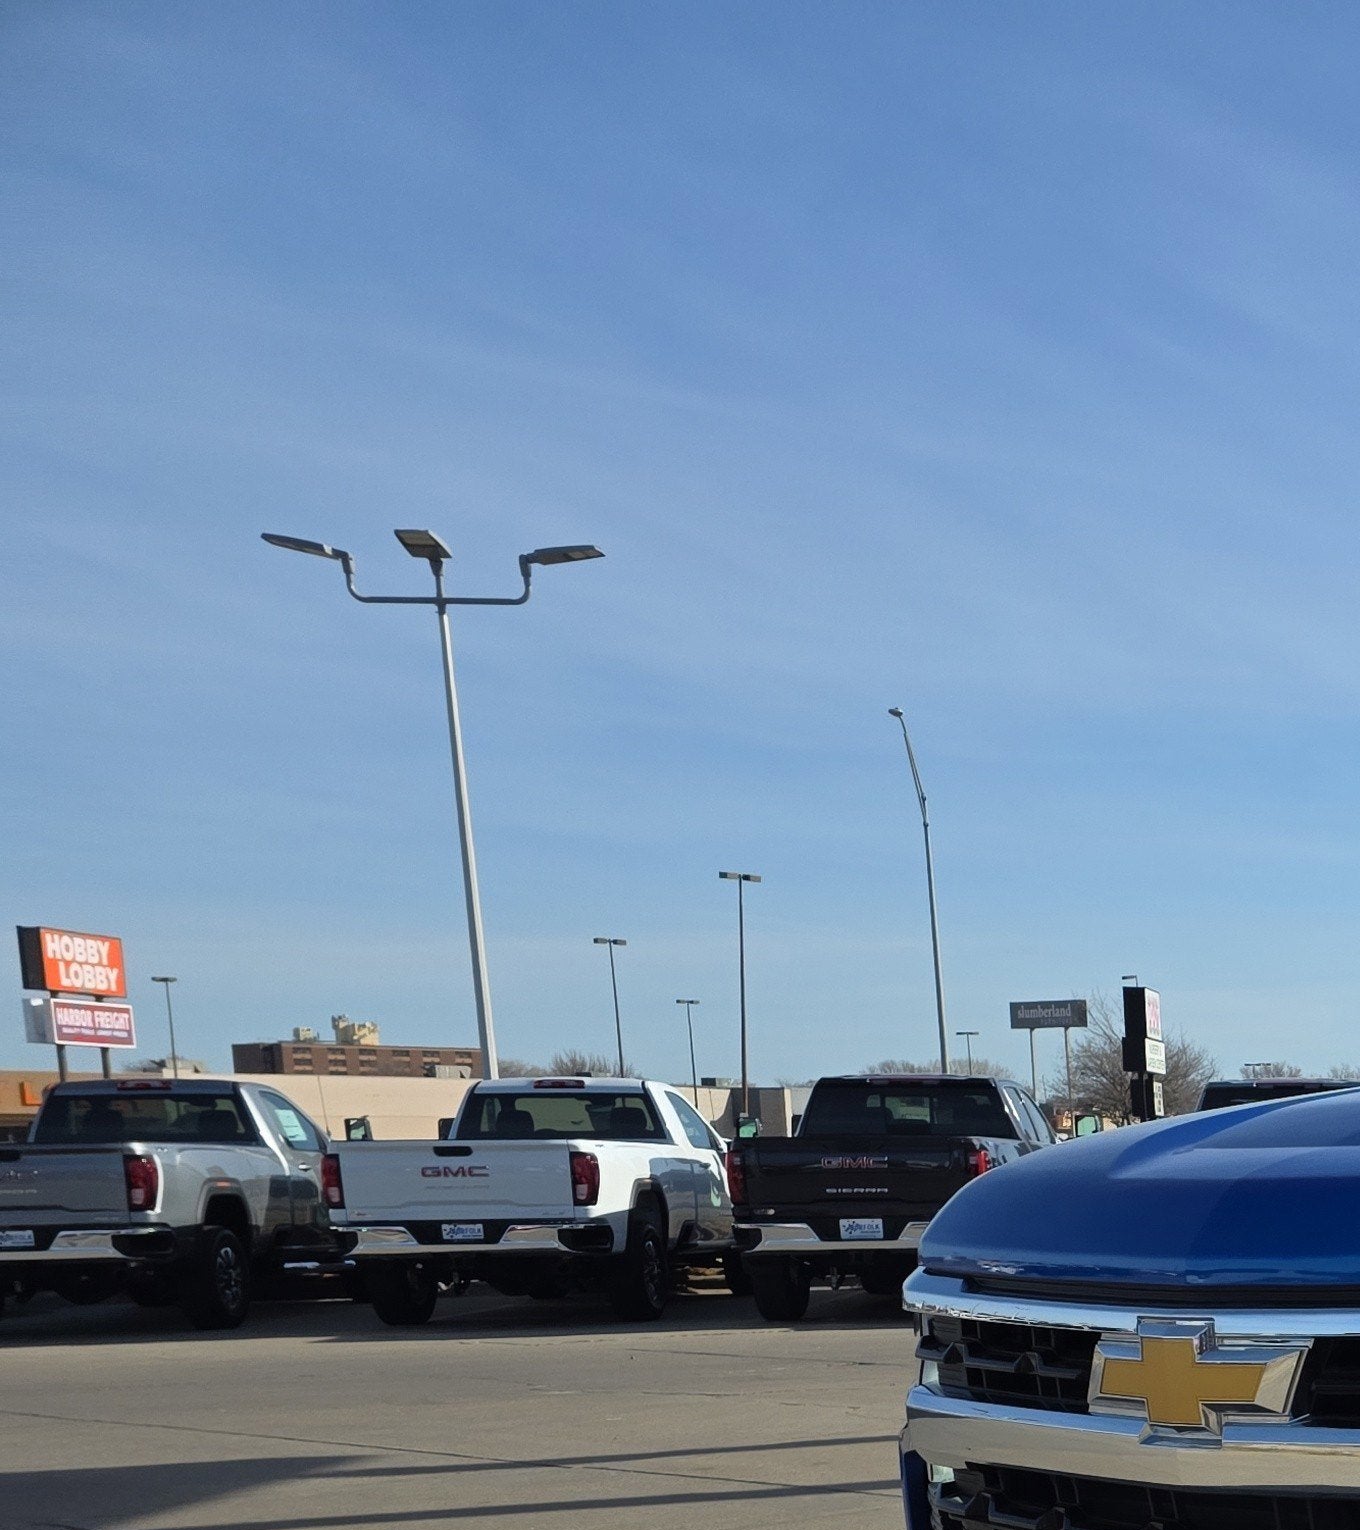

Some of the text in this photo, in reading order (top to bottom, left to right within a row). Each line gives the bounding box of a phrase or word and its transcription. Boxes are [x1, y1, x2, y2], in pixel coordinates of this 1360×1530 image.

[45, 933, 110, 965] HOBBY
[58, 961, 119, 991] LOBBY
[56, 1007, 130, 1031] HARBOR FREIGHT
[1017, 1004, 1072, 1019] slumberland
[421, 1165, 490, 1178] GMC
[822, 1156, 889, 1169] GMC
